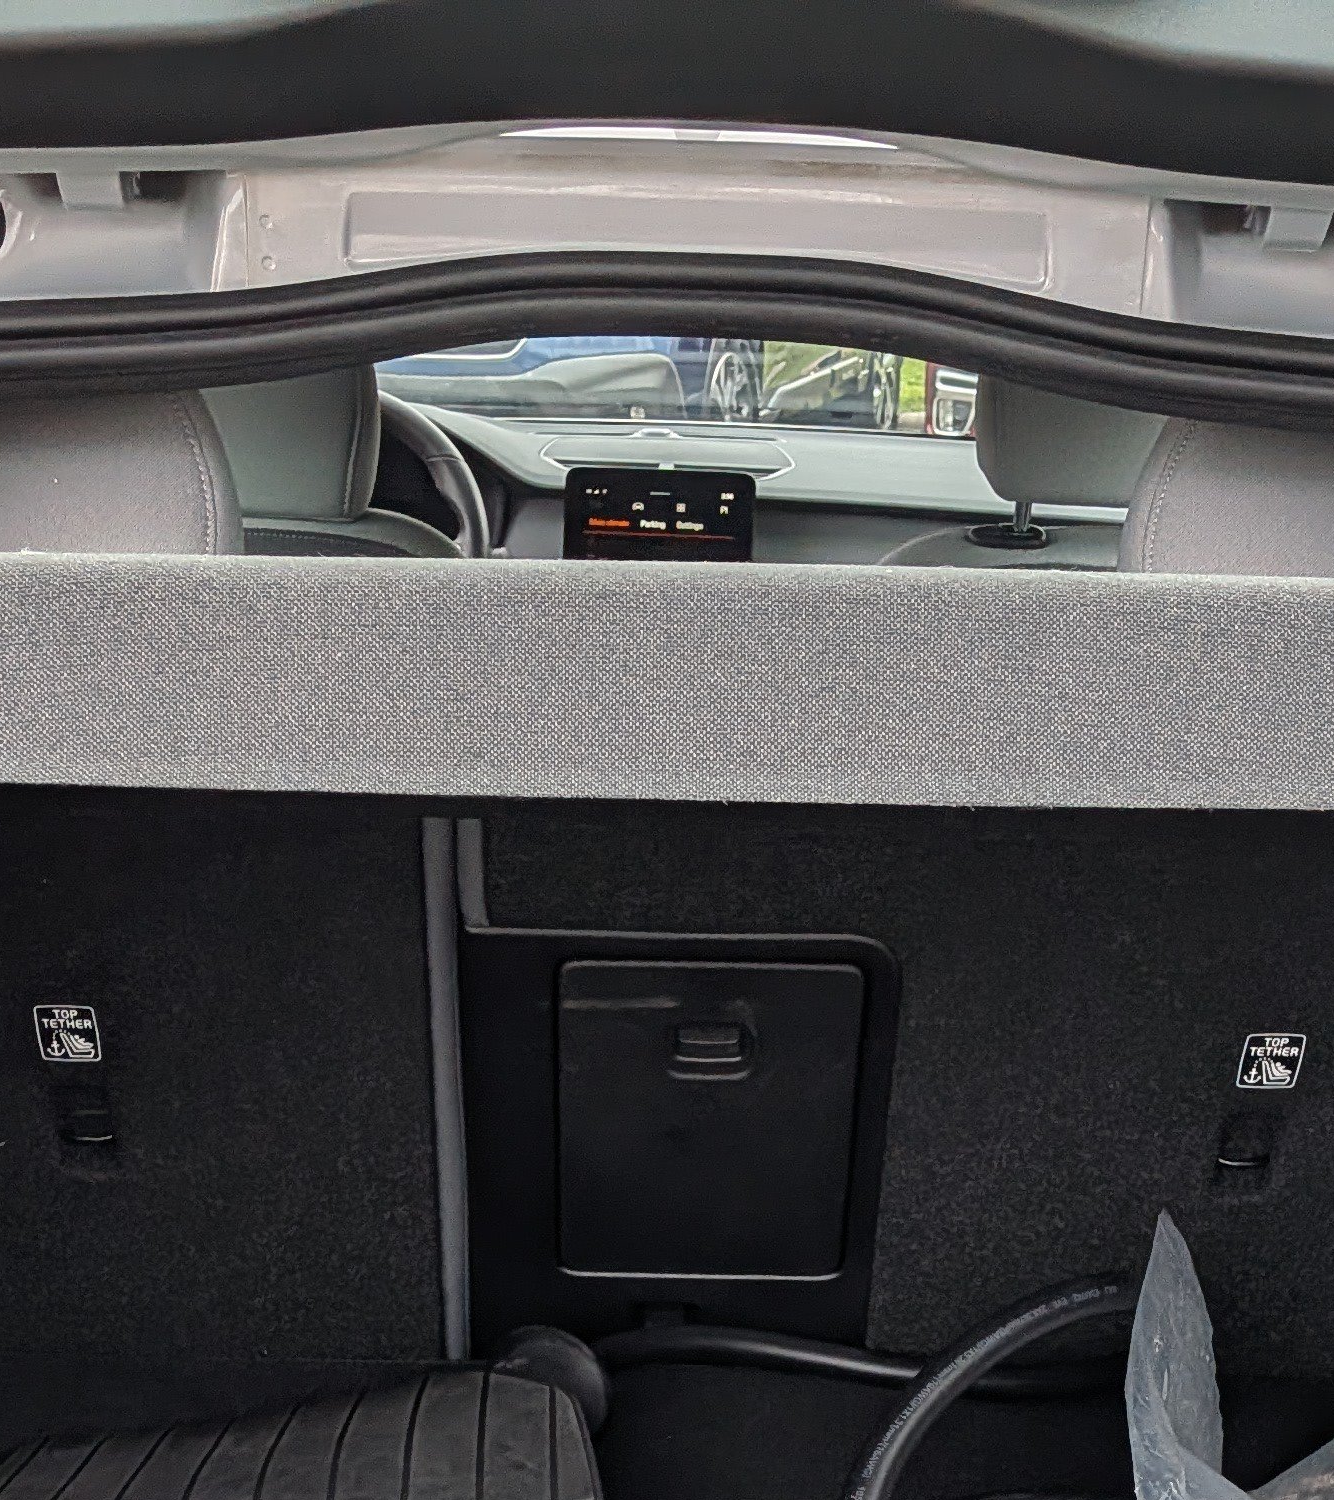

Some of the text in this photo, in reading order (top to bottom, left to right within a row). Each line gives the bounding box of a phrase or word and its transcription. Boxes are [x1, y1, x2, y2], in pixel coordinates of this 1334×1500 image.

[52, 1009, 78, 1020] TOP
[41, 1018, 93, 1030] TETHER
[1264, 1037, 1290, 1047] TOP
[1249, 1046, 1300, 1058] TETHER
